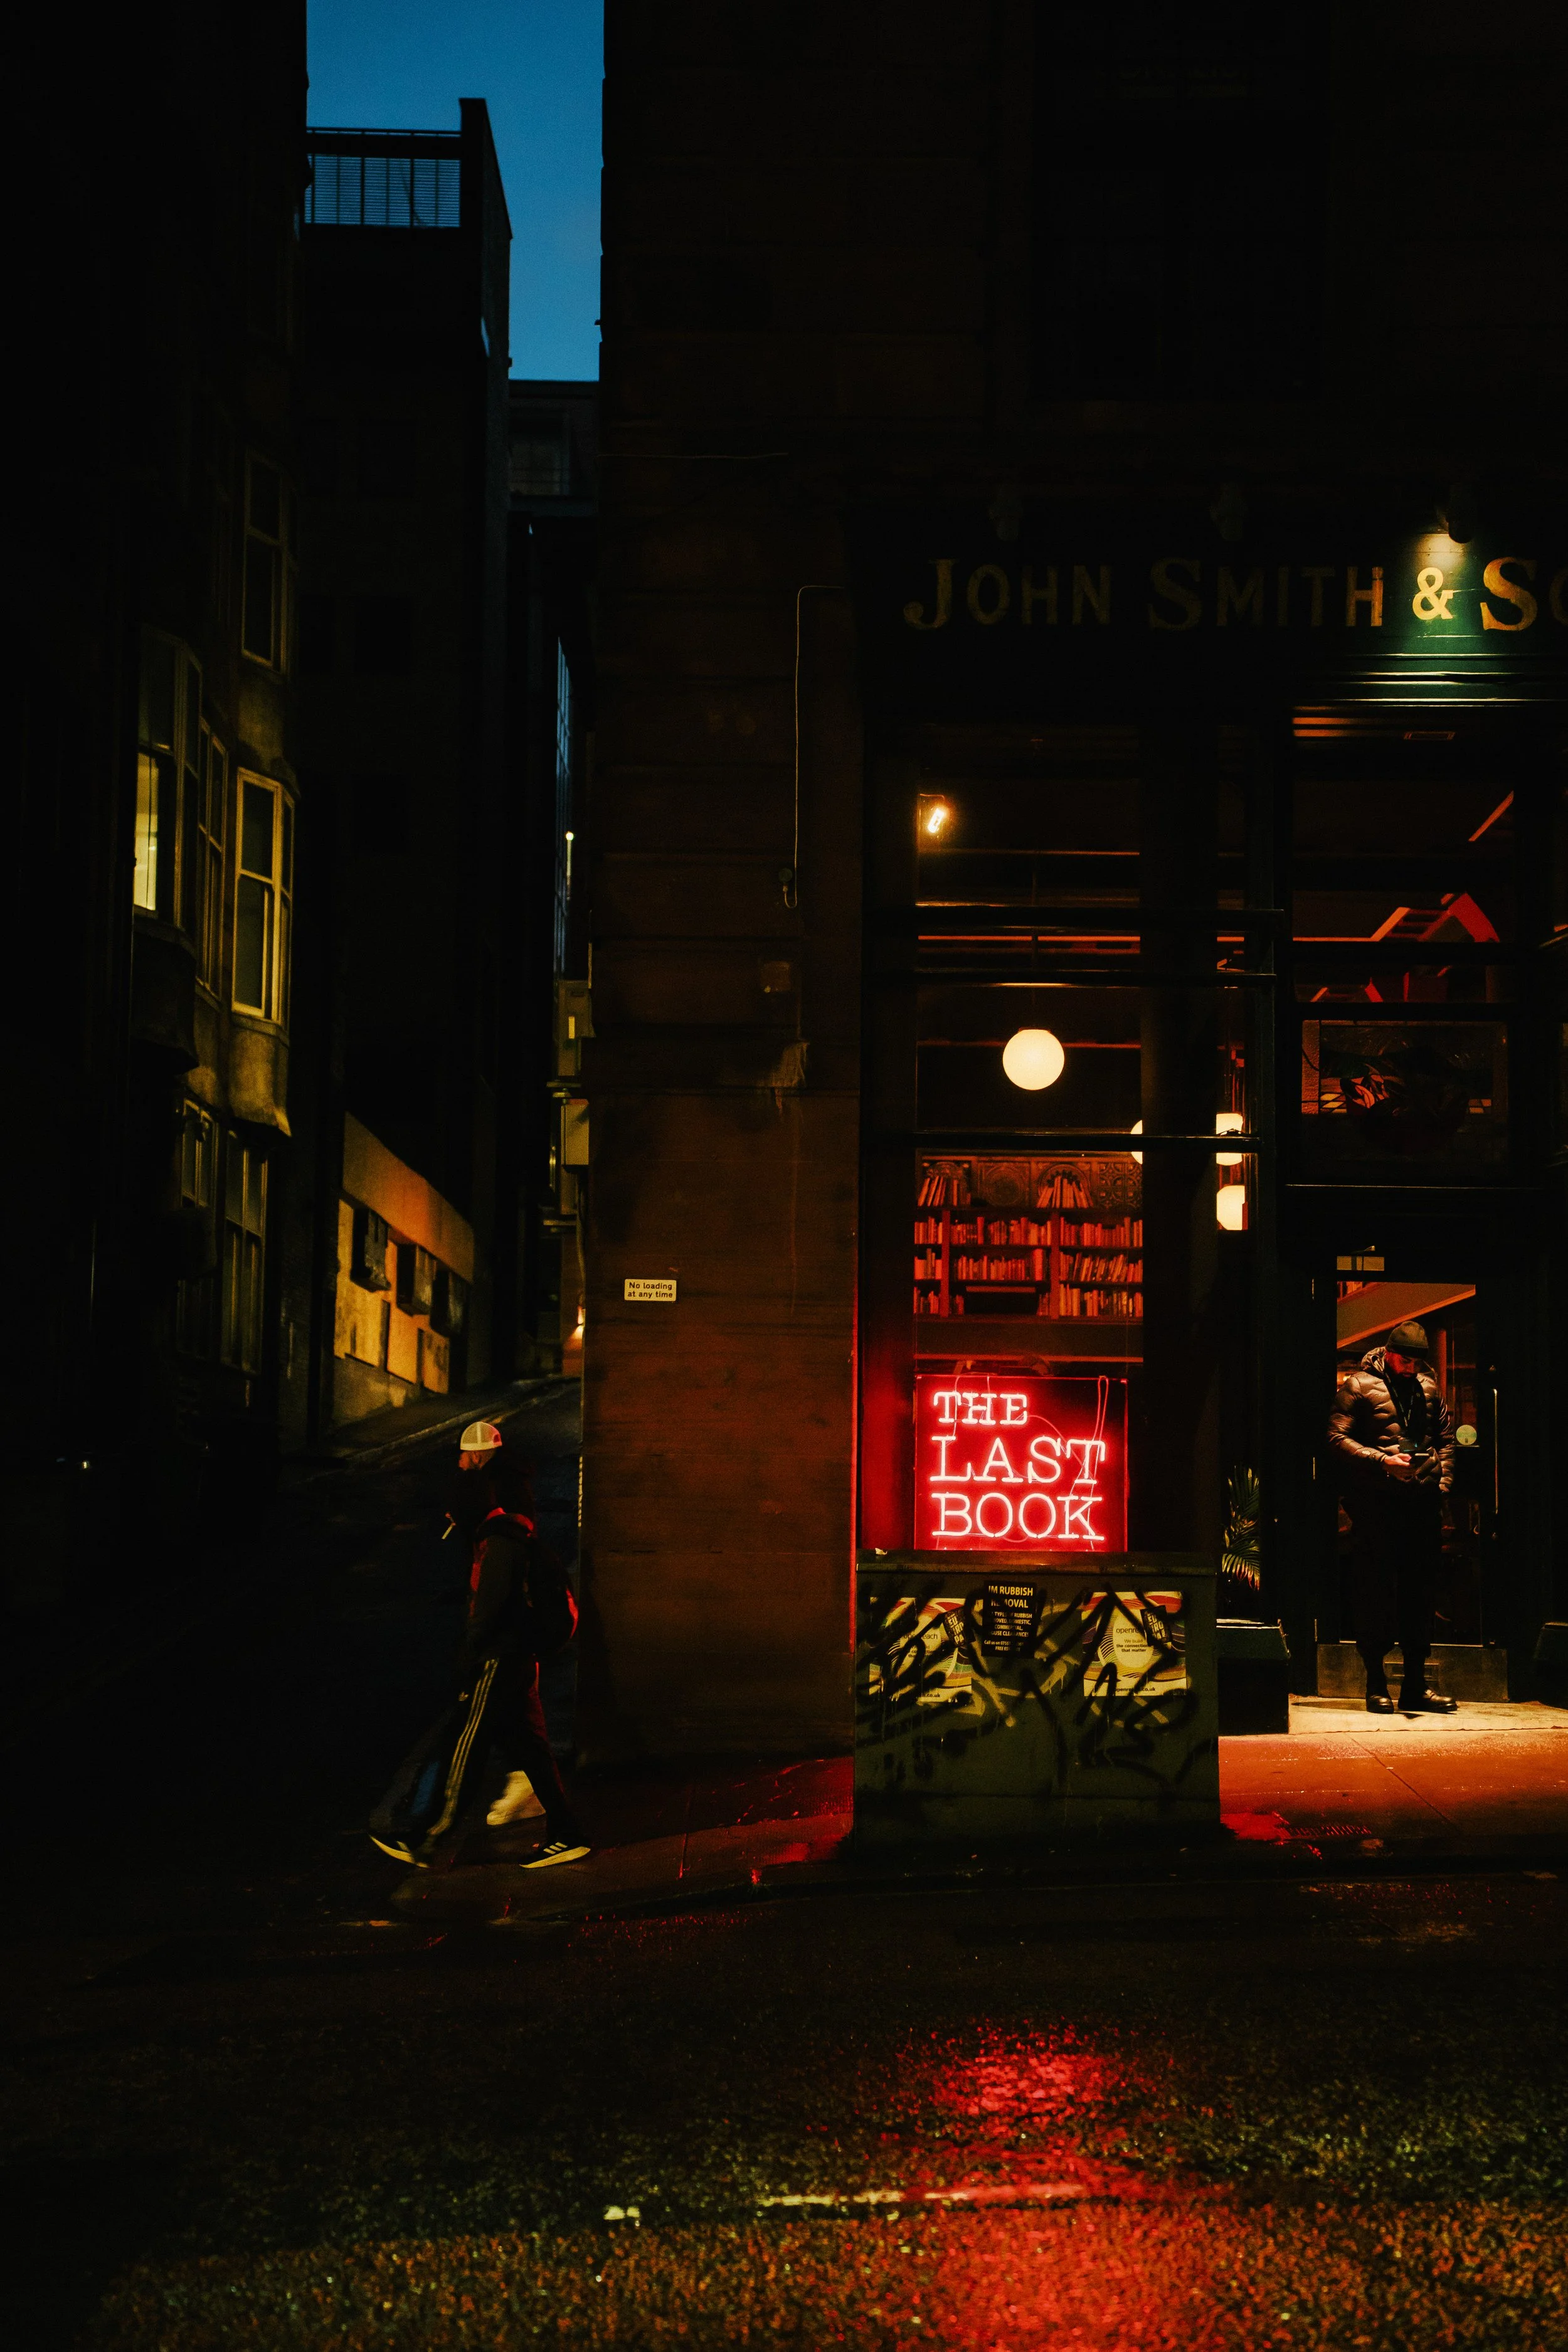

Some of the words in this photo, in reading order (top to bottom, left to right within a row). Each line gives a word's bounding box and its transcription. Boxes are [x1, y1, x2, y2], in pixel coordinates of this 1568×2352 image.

[903, 558, 1111, 630] JOHN
[1147, 557, 1385, 631] SMITH
[1412, 567, 1454, 621] &
[643, 1282, 672, 1291] loading
[933, 1391, 1027, 1425] THE
[930, 1435, 1106, 1484] LAST
[931, 1492, 1105, 1540] BOOK
[999, 1586, 1034, 1597] RUBBISH
